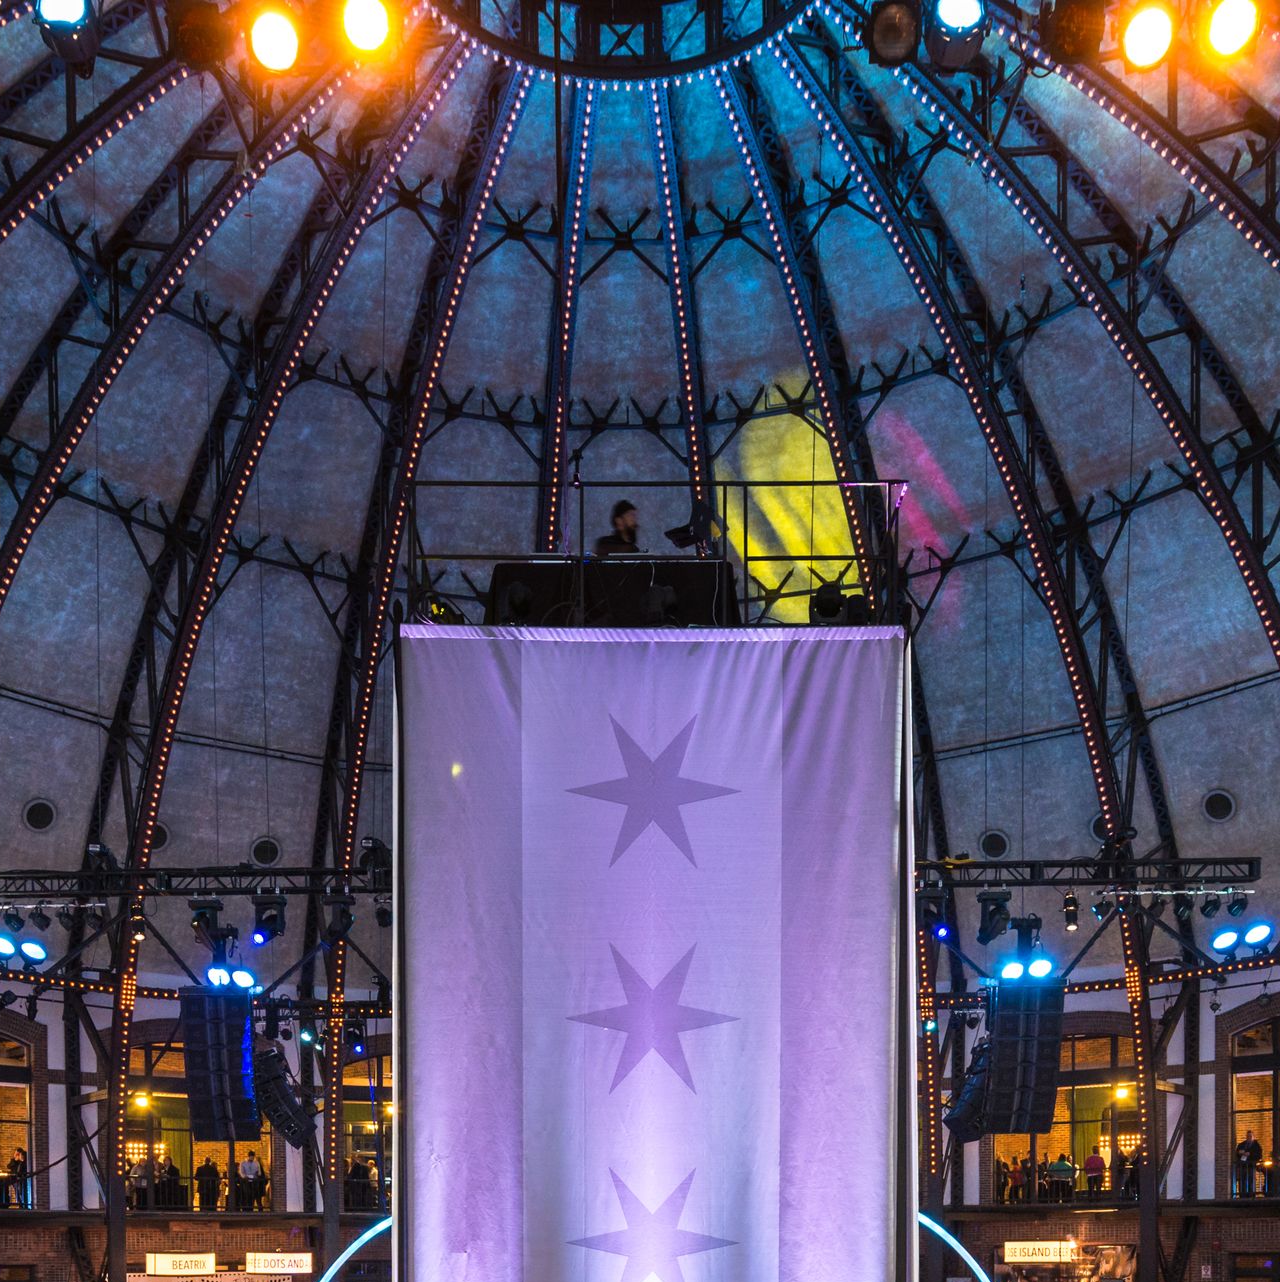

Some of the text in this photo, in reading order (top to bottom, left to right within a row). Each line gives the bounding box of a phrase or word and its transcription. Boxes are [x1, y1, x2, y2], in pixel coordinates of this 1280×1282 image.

[1020, 1247, 1050, 1257] ISLAND
[172, 1260, 206, 1270] BEATRIX
[263, 1259, 286, 1269] DOTS
[287, 1259, 305, 1269] AND
